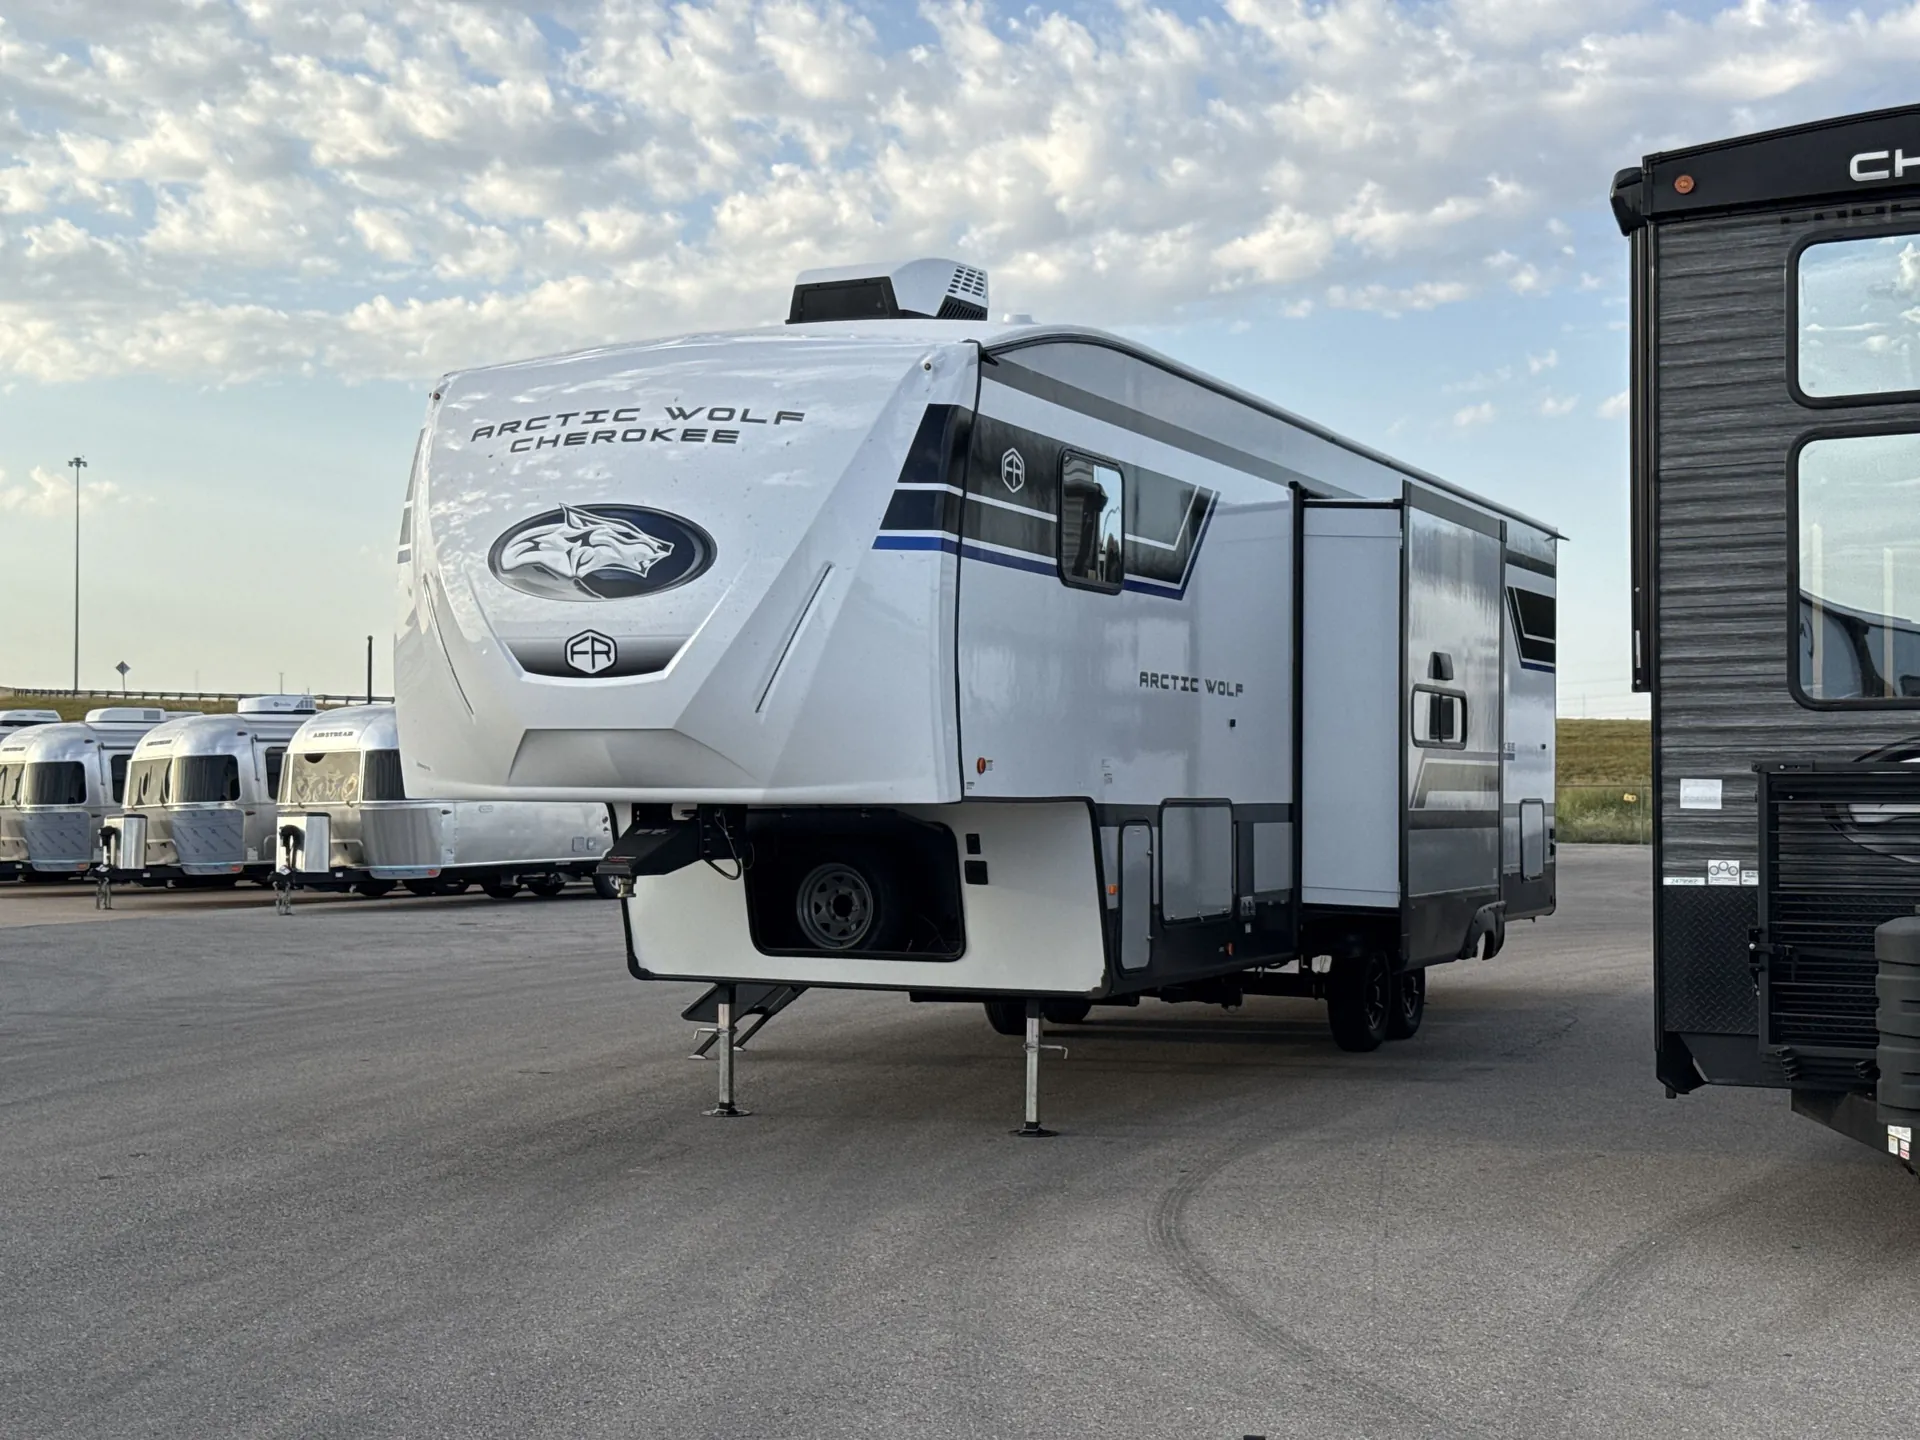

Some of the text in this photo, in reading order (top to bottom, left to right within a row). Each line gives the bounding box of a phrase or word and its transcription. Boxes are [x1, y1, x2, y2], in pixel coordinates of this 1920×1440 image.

[470, 406, 805, 442] ARCTIC WOLF
[510, 428, 740, 453] CHEROKEE
[1139, 671, 1244, 697] ARCTIC WOLF
